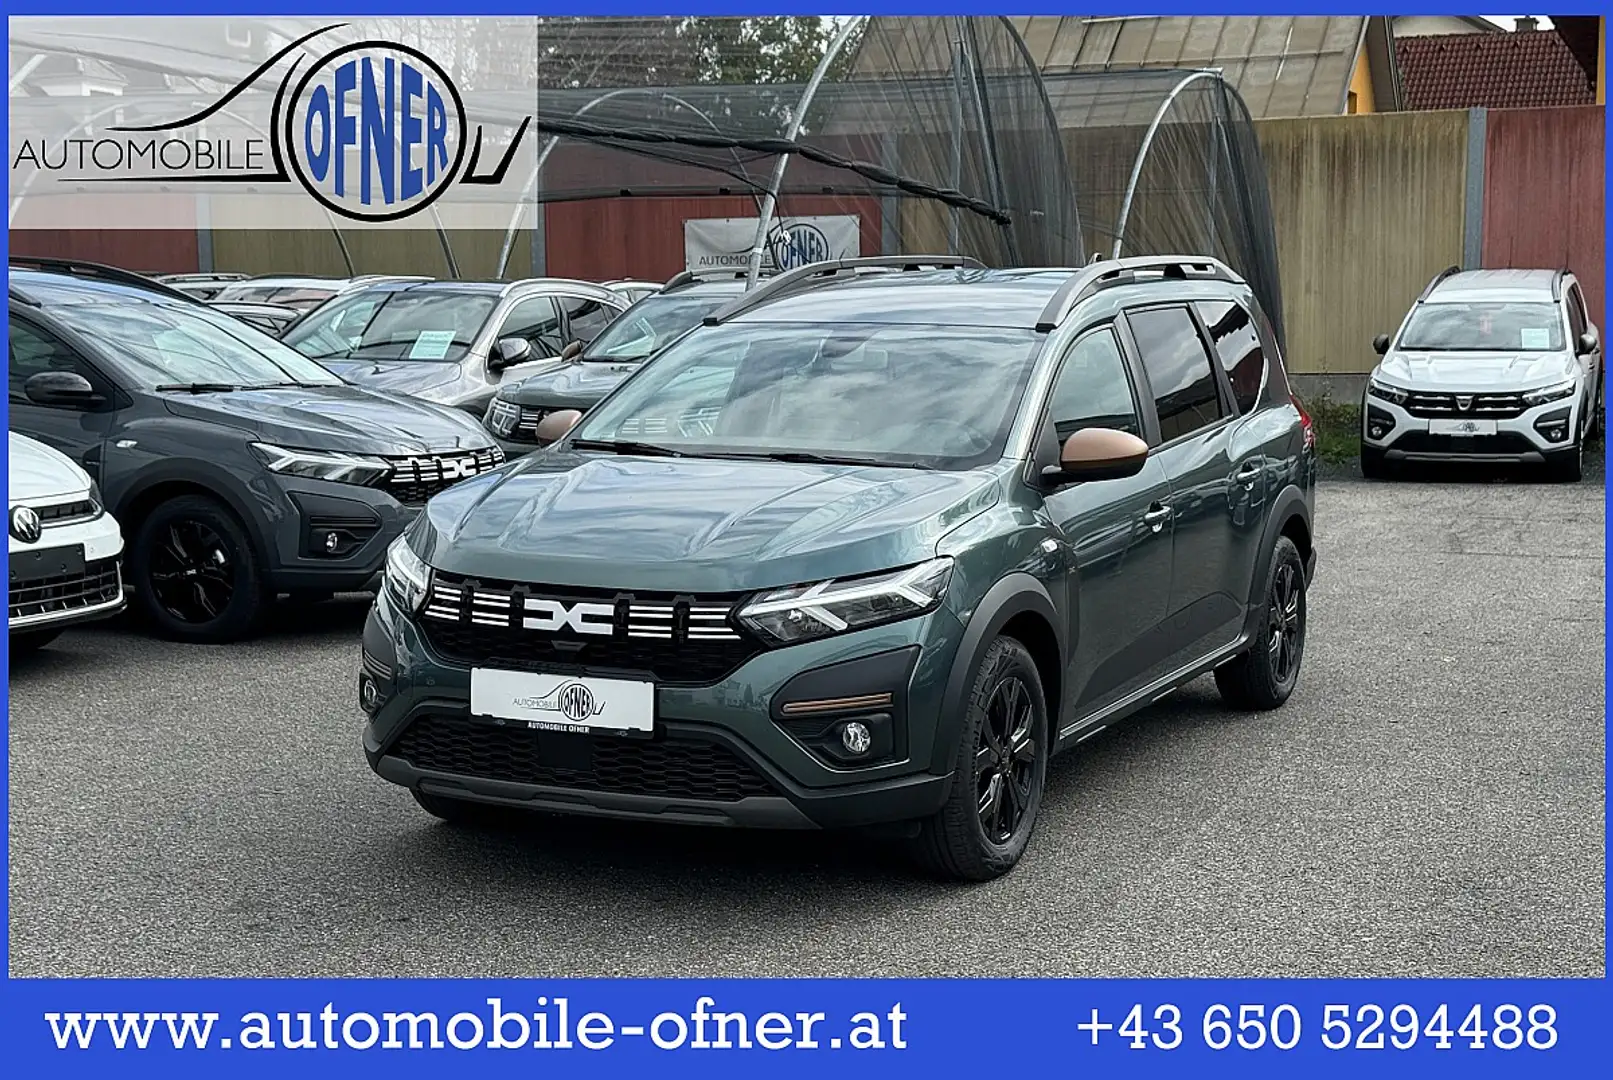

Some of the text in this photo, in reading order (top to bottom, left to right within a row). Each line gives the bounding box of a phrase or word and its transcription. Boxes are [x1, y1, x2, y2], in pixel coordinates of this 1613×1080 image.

[699, 255, 772, 266] AUTOMOE
[564, 687, 591, 718] OFNER
[527, 721, 590, 734] AUTOMOBILE OFNER
